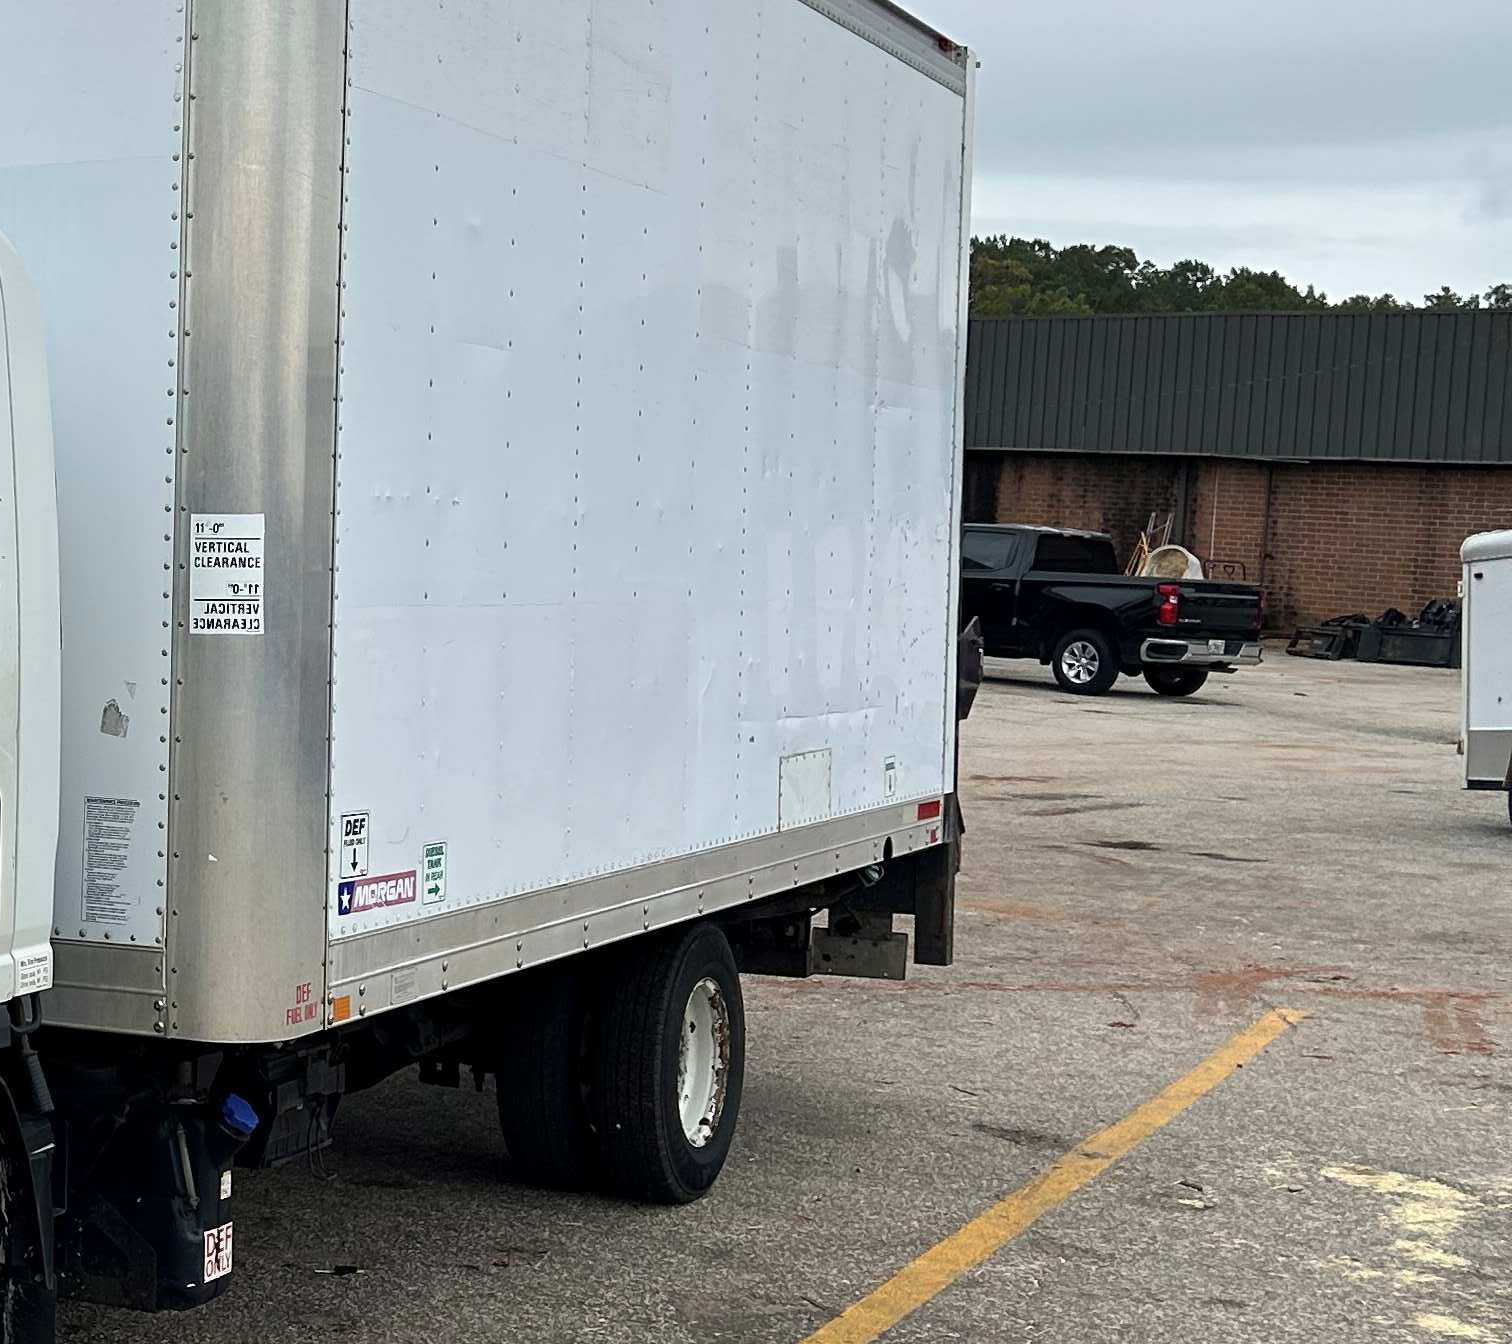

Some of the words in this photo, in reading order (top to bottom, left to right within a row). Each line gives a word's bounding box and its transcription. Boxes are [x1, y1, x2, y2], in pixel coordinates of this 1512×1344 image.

[194, 541, 249, 553] VERTICAL
[194, 556, 261, 568] CLEARANCE
[345, 818, 365, 836] DEF
[353, 876, 415, 908] MORGAN
[296, 982, 312, 1004] DEF
[286, 1007, 302, 1025] FUEL
[207, 1225, 232, 1258] DEF
[206, 1252, 232, 1278] ONLY
